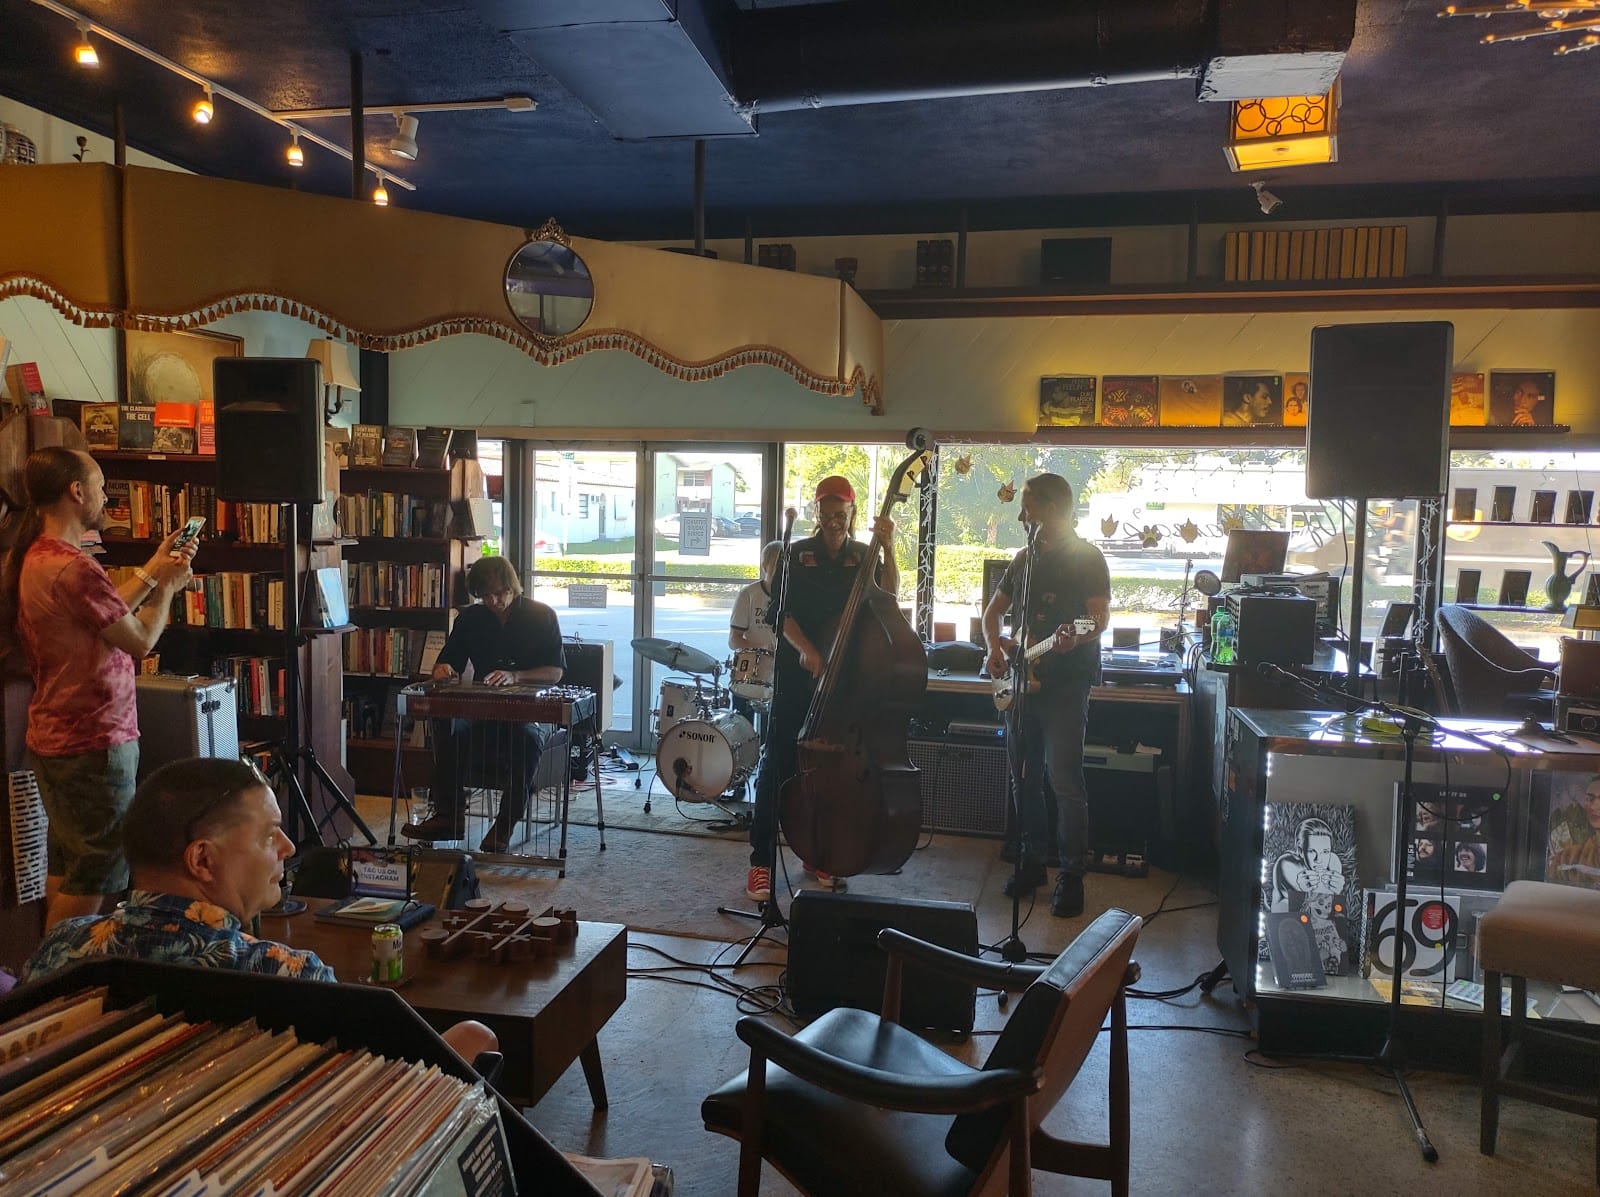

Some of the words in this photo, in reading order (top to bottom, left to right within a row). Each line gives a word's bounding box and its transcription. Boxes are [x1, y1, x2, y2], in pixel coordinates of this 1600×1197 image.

[137, 412, 151, 421] CELL
[686, 731, 716, 743] SONOR
[363, 866, 377, 874] TAG
[386, 868, 399, 876] ON
[361, 873, 400, 882] INSTAGRAM
[1371, 898, 1459, 977] 69
